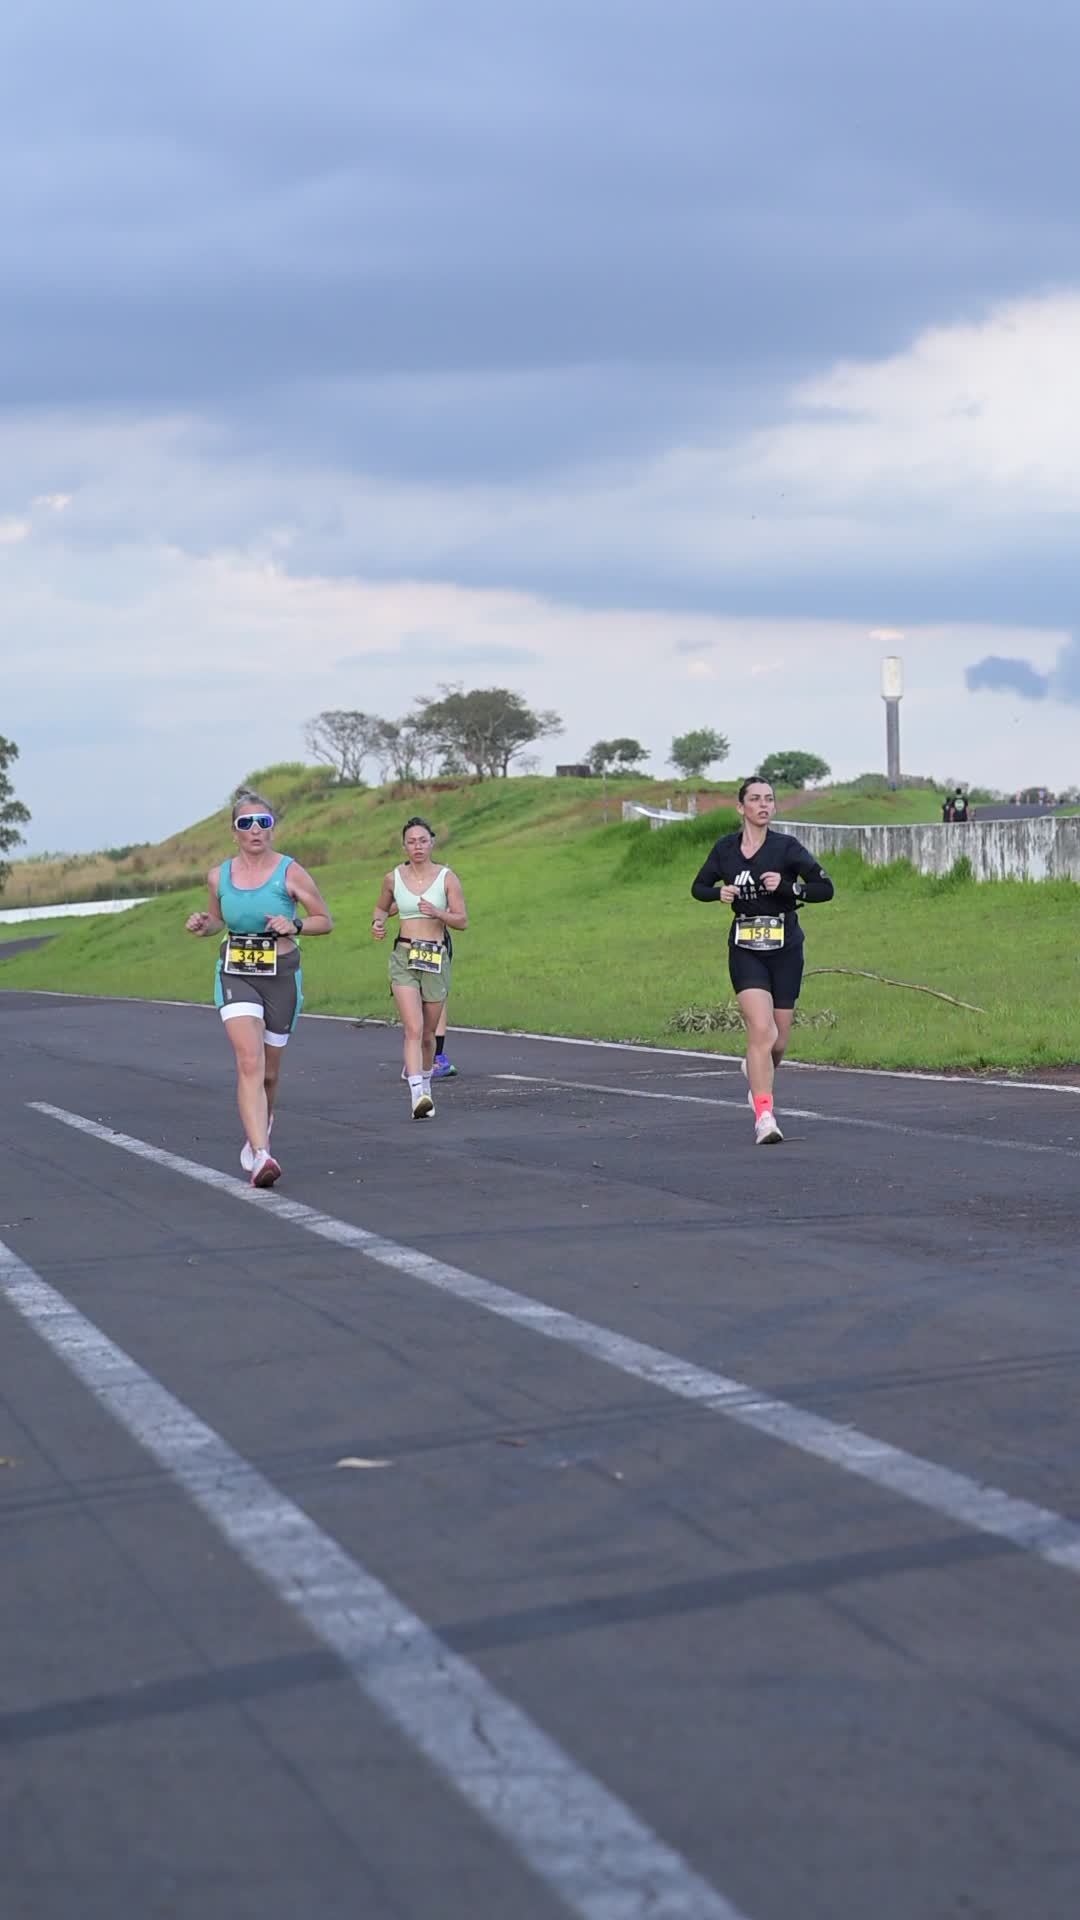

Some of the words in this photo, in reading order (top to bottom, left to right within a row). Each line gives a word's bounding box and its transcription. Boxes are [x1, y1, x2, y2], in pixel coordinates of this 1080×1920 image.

[750, 927, 770, 939] 158
[238, 950, 264, 963] 342
[414, 950, 433, 962] 393
